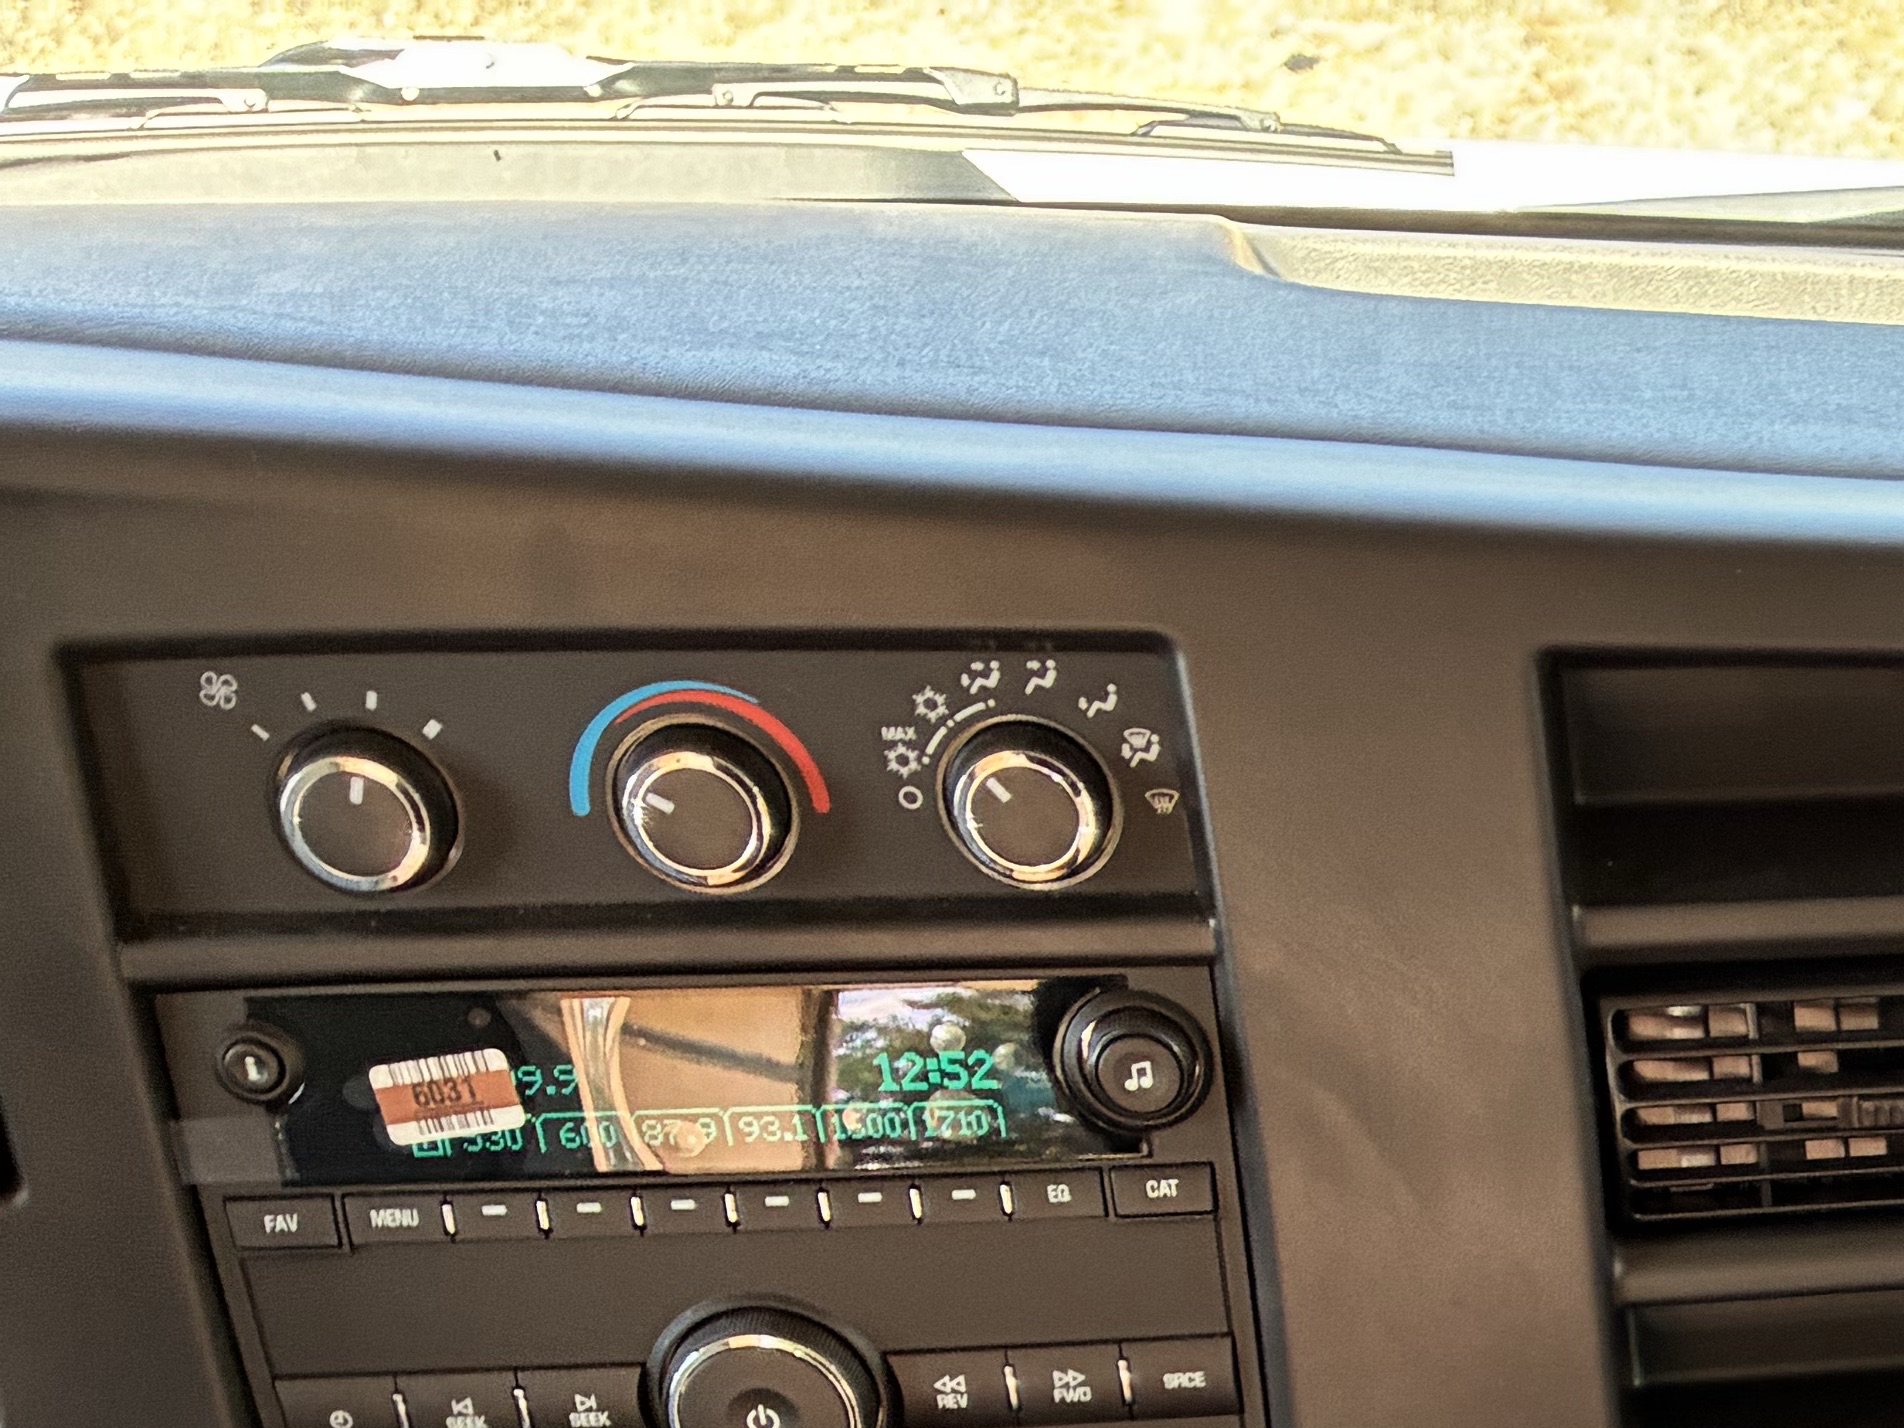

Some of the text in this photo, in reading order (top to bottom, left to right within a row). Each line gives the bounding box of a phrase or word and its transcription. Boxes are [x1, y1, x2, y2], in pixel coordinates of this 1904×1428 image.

[881, 726, 916, 741] MAX
[511, 1063, 578, 1096] 9.9
[873, 1050, 1001, 1092] 12:52
[411, 1077, 477, 1107] 6031
[642, 1118, 717, 1147] 879
[738, 1115, 808, 1143] 93.1
[922, 1110, 990, 1138] 1710
[1047, 1184, 1072, 1203] EQ
[1146, 1178, 1179, 1199] CAT
[263, 1213, 298, 1234] FAV
[369, 1207, 420, 1228] MENU
[1163, 1371, 1206, 1390] SRCE
[936, 1393, 968, 1410] REV
[1053, 1386, 1092, 1403] FWD
[569, 1410, 612, 1428] SEEK
